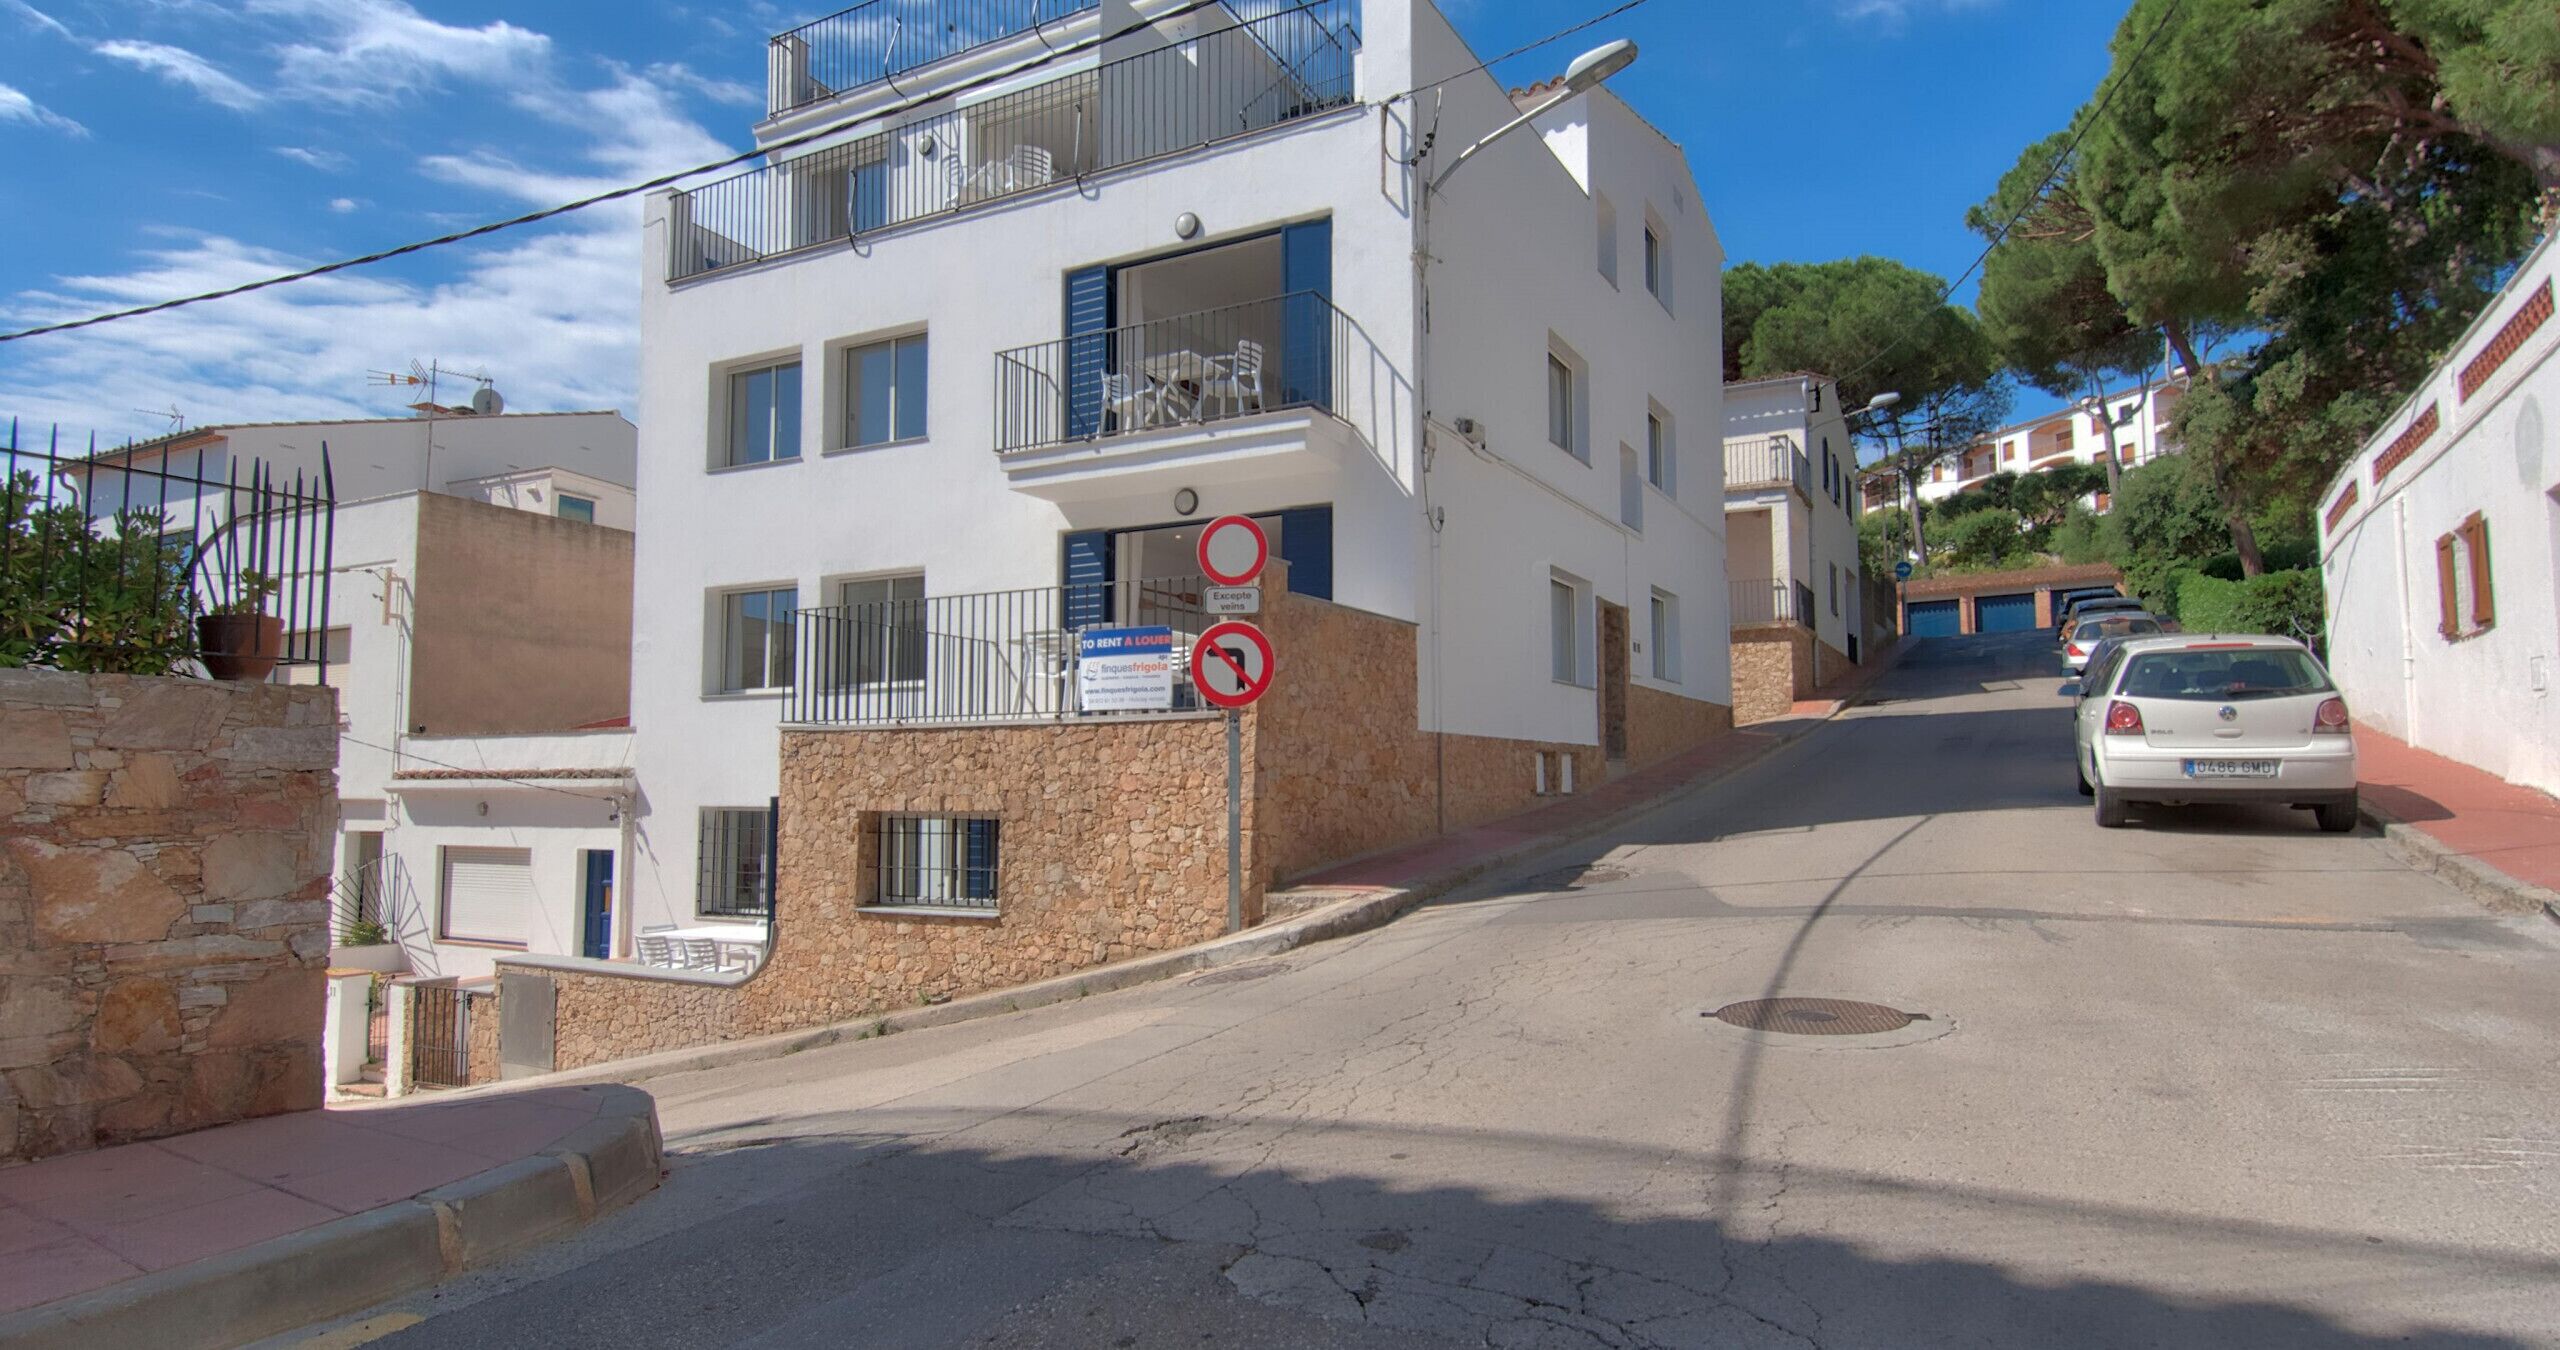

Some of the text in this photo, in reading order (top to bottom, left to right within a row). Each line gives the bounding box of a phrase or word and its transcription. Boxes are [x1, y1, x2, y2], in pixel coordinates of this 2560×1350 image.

[1213, 591, 1252, 601] Excepte
[1082, 634, 1172, 650] TO RENT A LOUER
[2197, 761, 2271, 773] 0486 GMD
